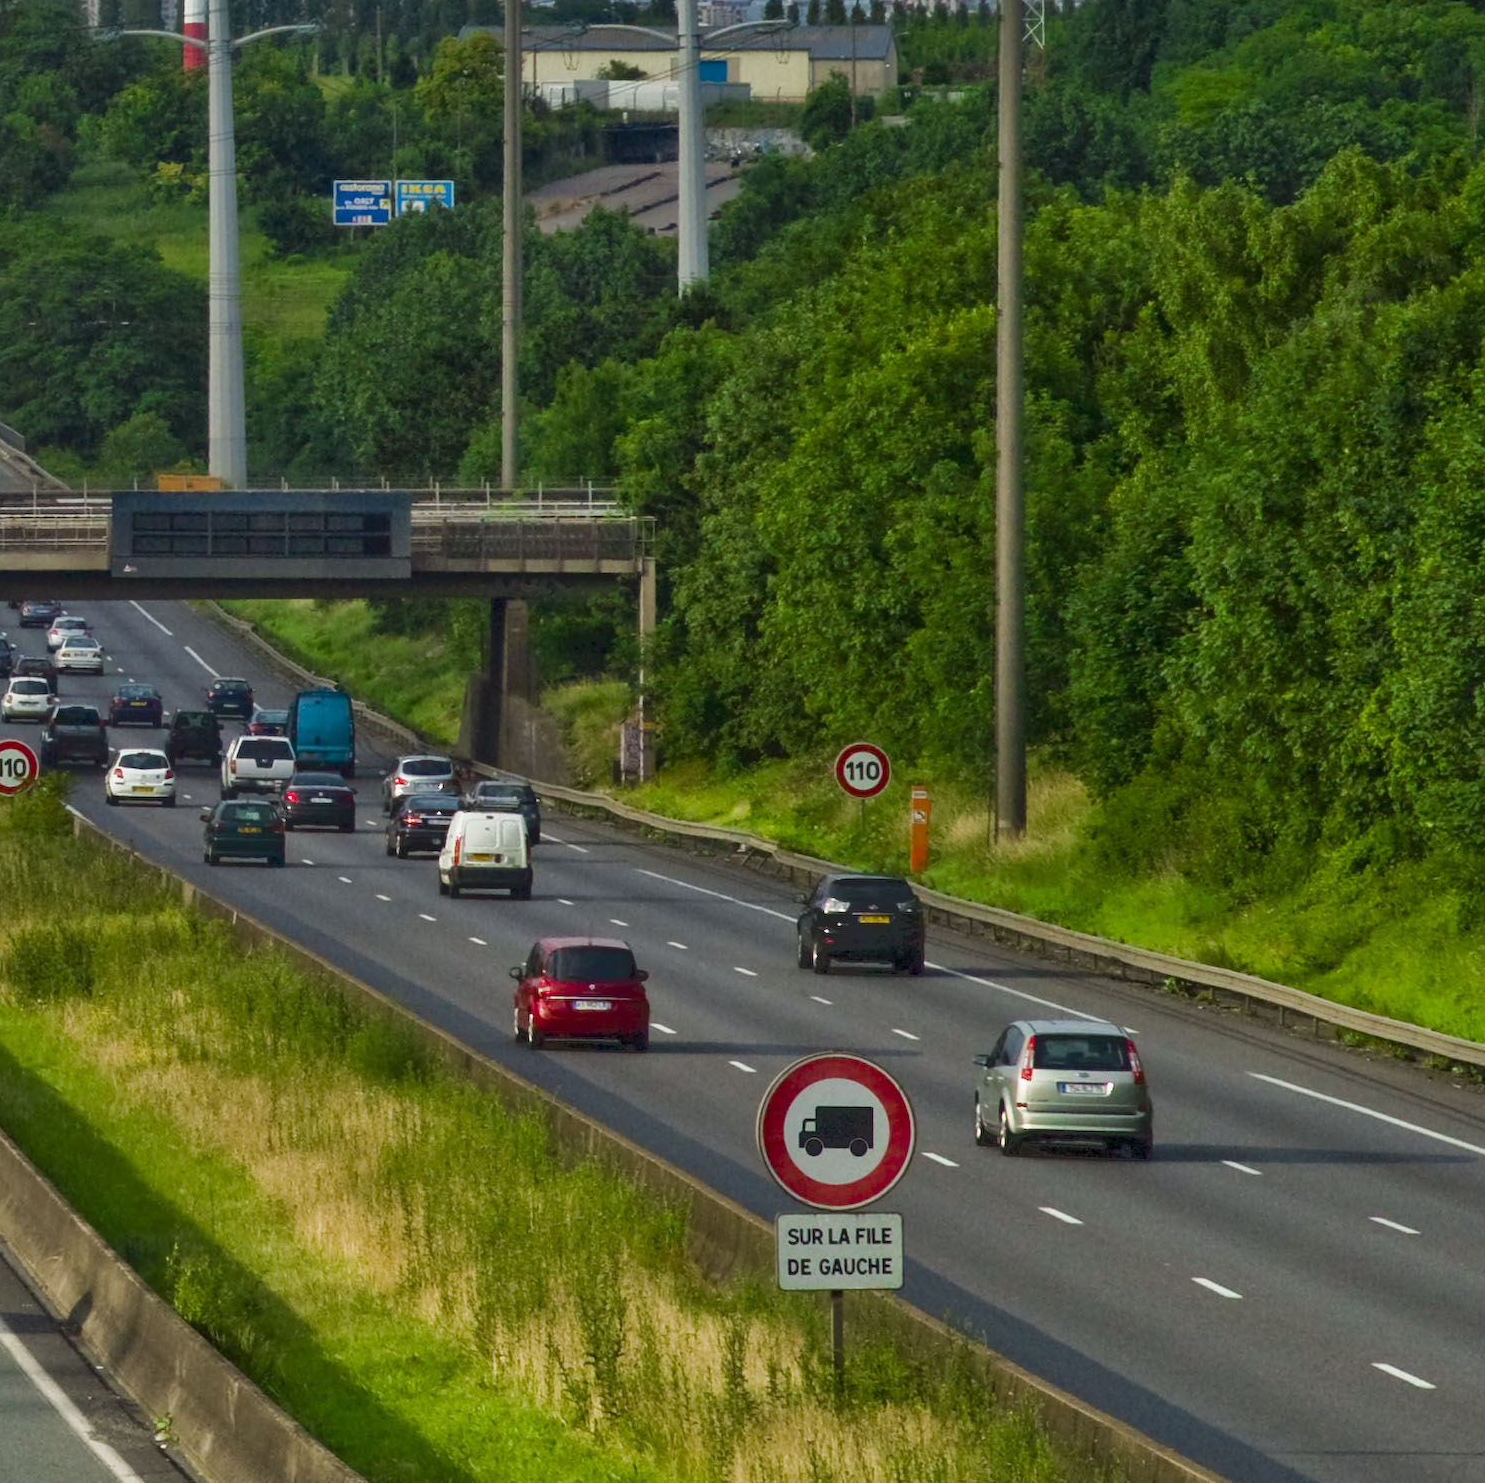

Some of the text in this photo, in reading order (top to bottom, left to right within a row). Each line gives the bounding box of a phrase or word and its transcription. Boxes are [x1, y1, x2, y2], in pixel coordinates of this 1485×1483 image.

[401, 185, 446, 193] IKEA
[846, 761, 880, 781] 110
[788, 1228, 892, 1245] SUR LA FILE
[788, 1258, 892, 1275] DE GAUCHE
